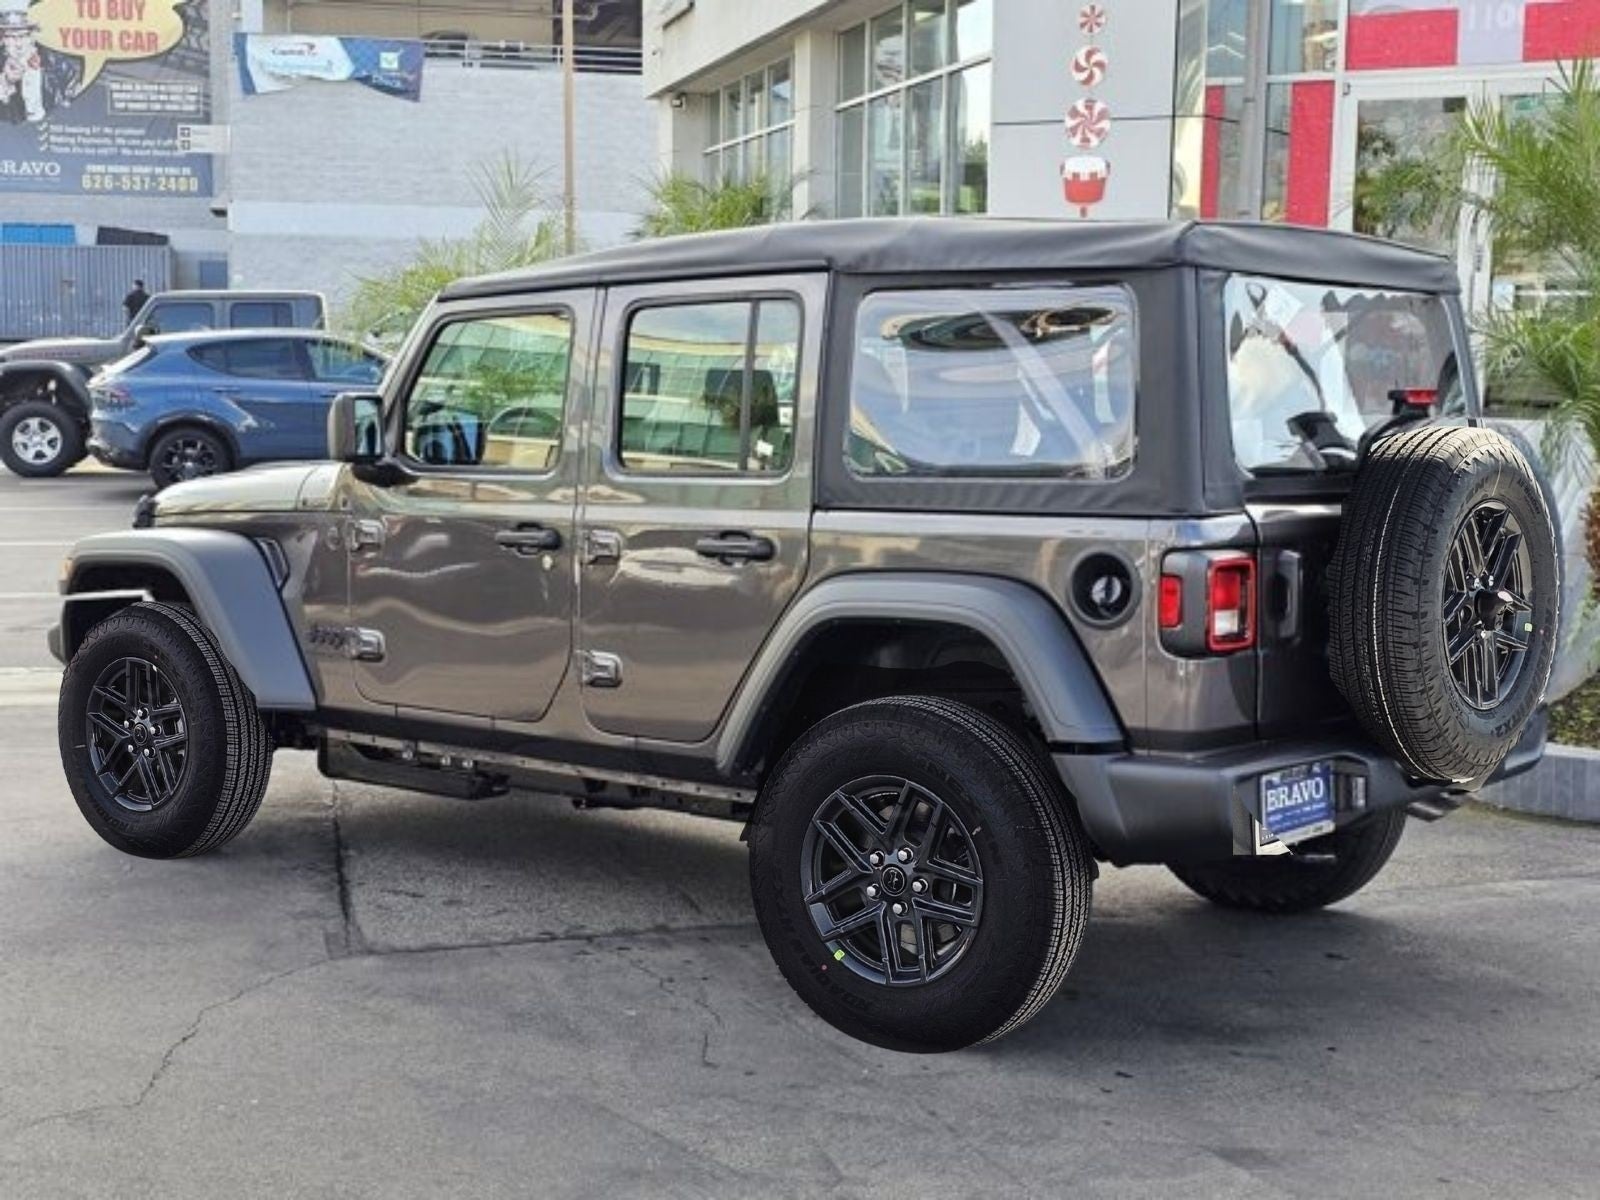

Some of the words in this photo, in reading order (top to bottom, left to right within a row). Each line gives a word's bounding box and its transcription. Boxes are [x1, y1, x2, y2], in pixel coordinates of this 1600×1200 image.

[77, 0, 100, 19] TO
[107, 0, 146, 20] BUY
[59, 27, 113, 51] YOUR
[119, 31, 159, 53] CAR
[1266, 777, 1324, 813] BRAVO
